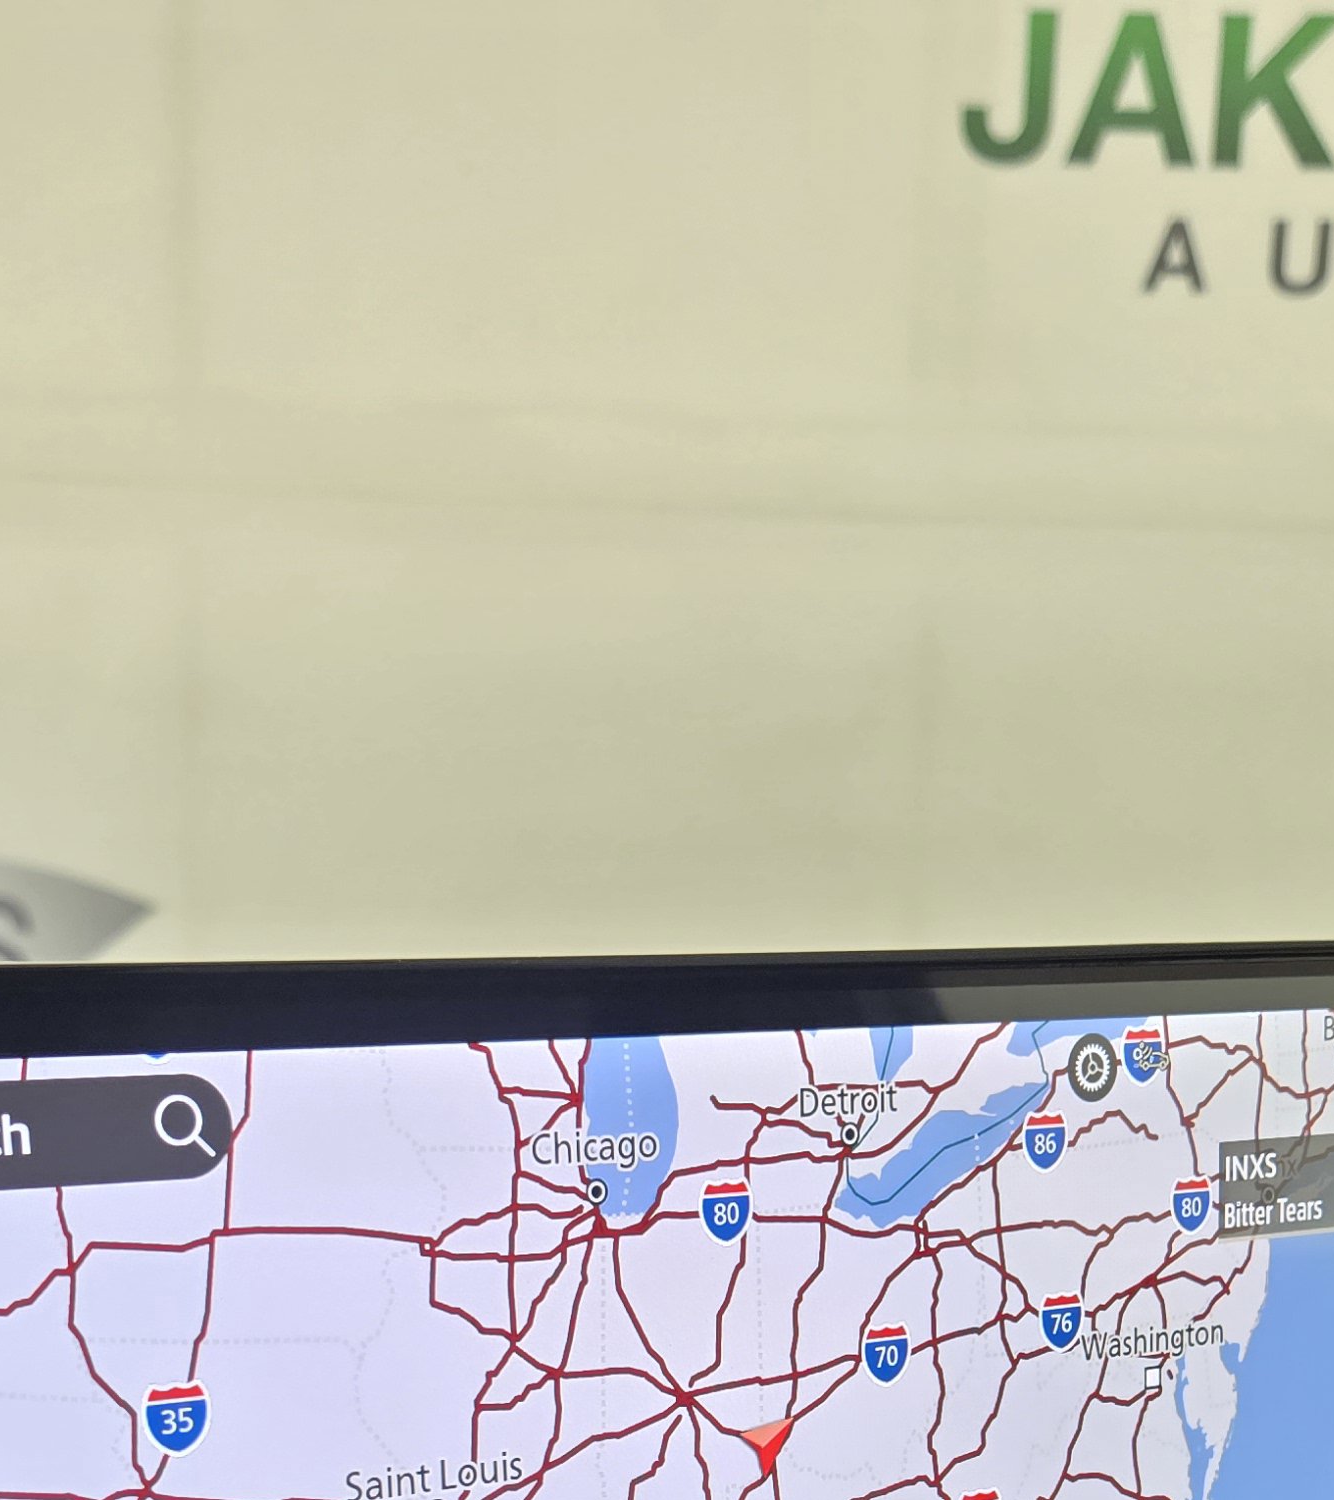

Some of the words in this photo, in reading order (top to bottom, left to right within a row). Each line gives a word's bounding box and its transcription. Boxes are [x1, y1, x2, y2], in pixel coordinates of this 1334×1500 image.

[798, 1085, 898, 1119] Detroit
[531, 1131, 659, 1169] Chicago
[1033, 1134, 1057, 1154] 86
[1225, 1153, 1277, 1181] INXS
[713, 1203, 739, 1225] 80
[1181, 1197, 1202, 1218] 80
[1224, 1203, 1274, 1229] Bitter
[1276, 1197, 1323, 1223] Tears
[1051, 1313, 1073, 1335] 76
[1082, 1323, 1224, 1361] Washington
[875, 1346, 898, 1366] 70
[160, 1408, 194, 1435] 35
[440, 1452, 524, 1492] Louis
